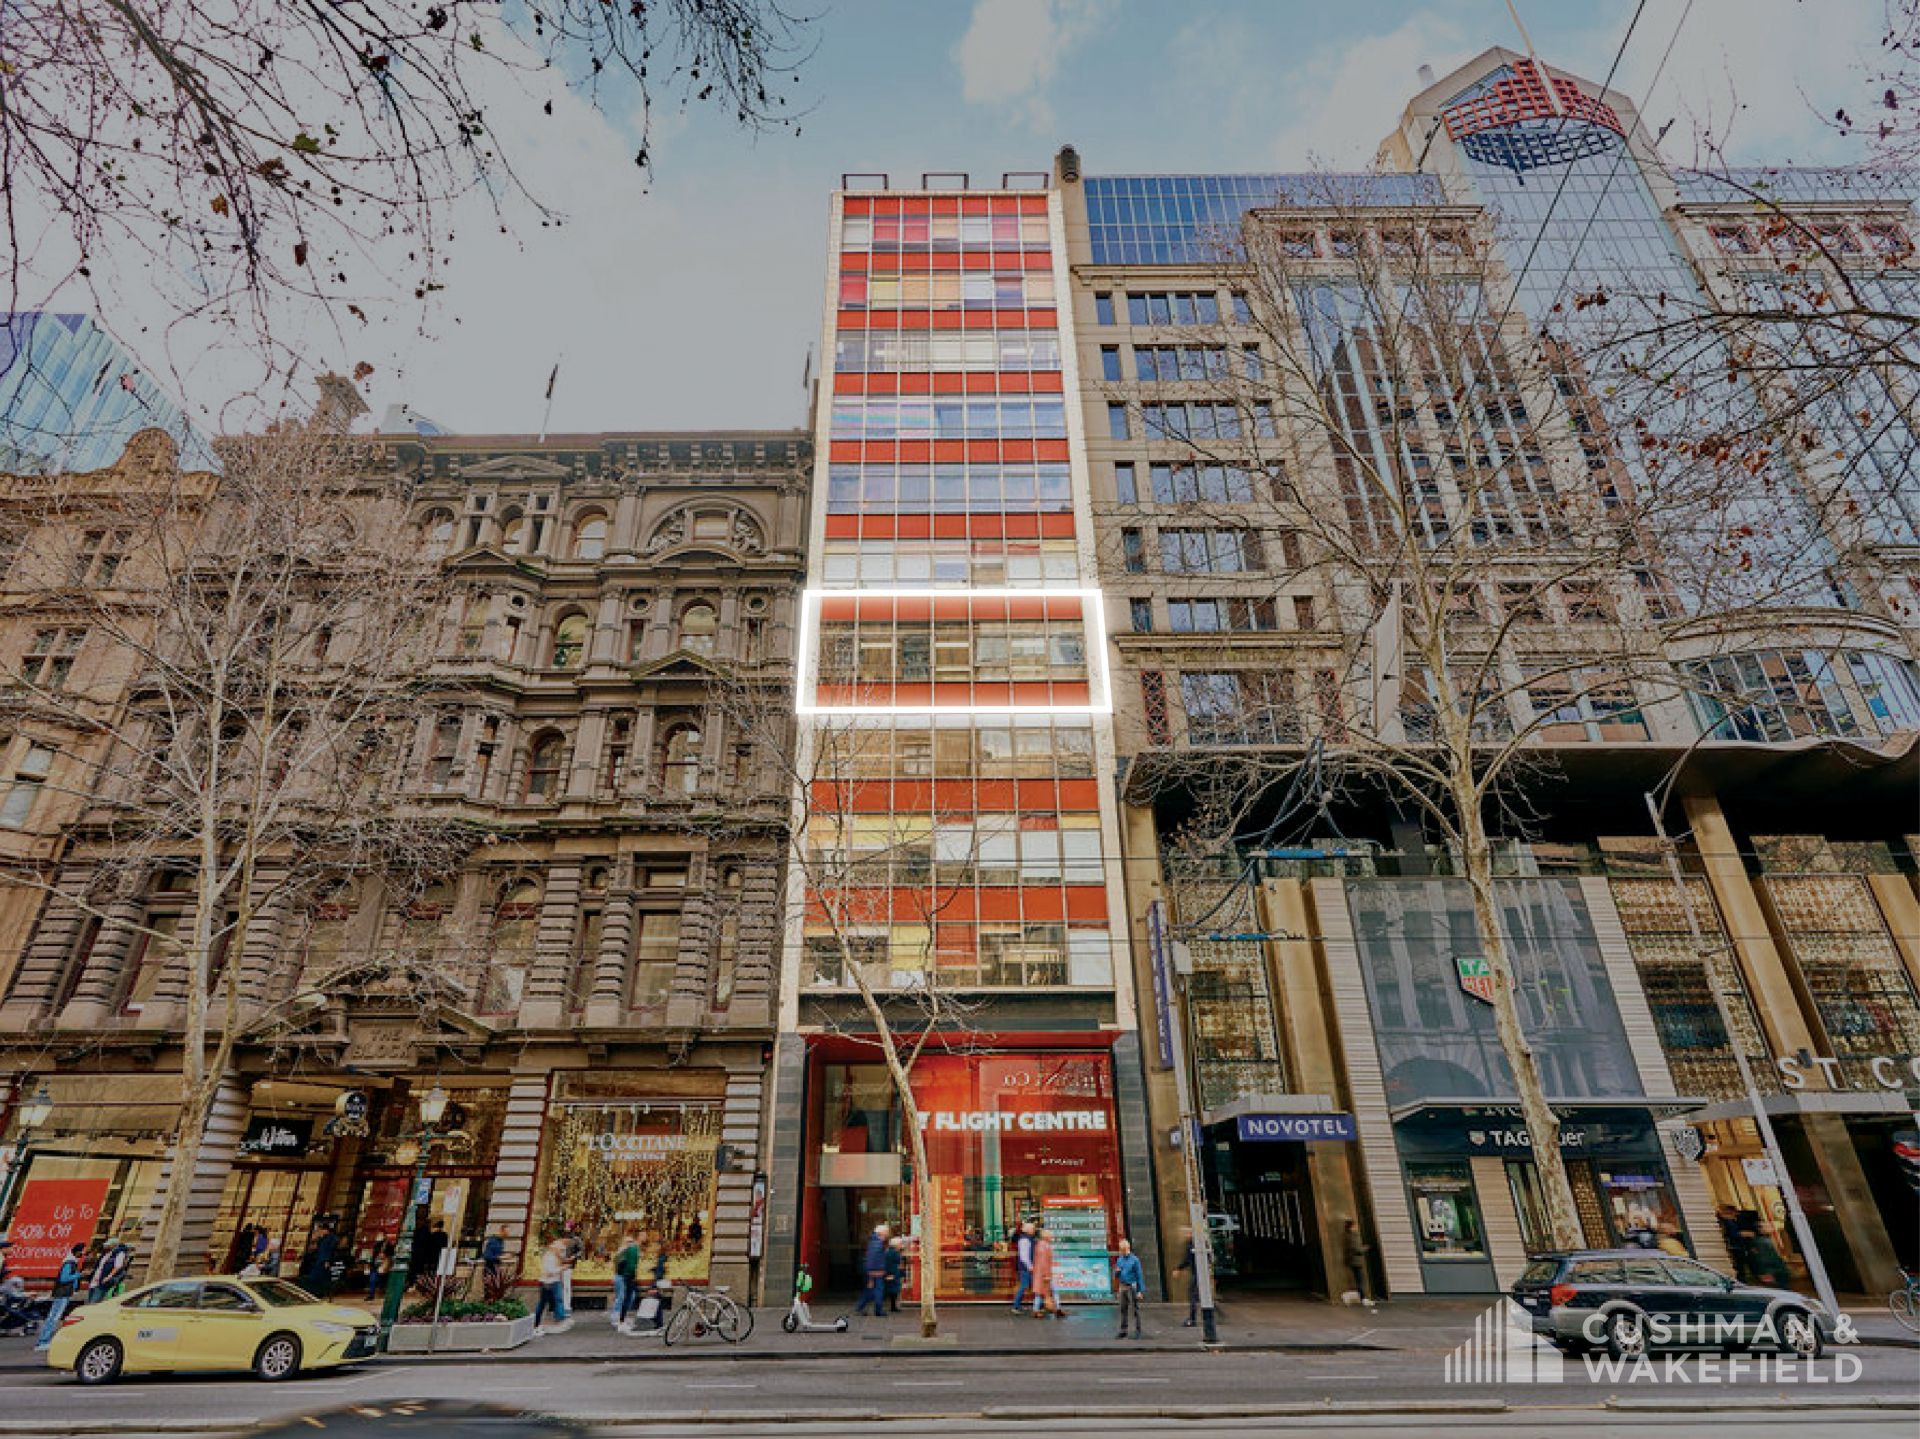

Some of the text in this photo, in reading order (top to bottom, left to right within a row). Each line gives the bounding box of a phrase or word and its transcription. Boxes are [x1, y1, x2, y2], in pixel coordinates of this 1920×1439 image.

[1460, 960, 1490, 976] TA
[935, 1110, 1015, 1131] FLIGHT
[1017, 1110, 1107, 1131] CENTRE
[1248, 1119, 1348, 1136] NOVOTEL
[53, 1203, 94, 1221] Up To
